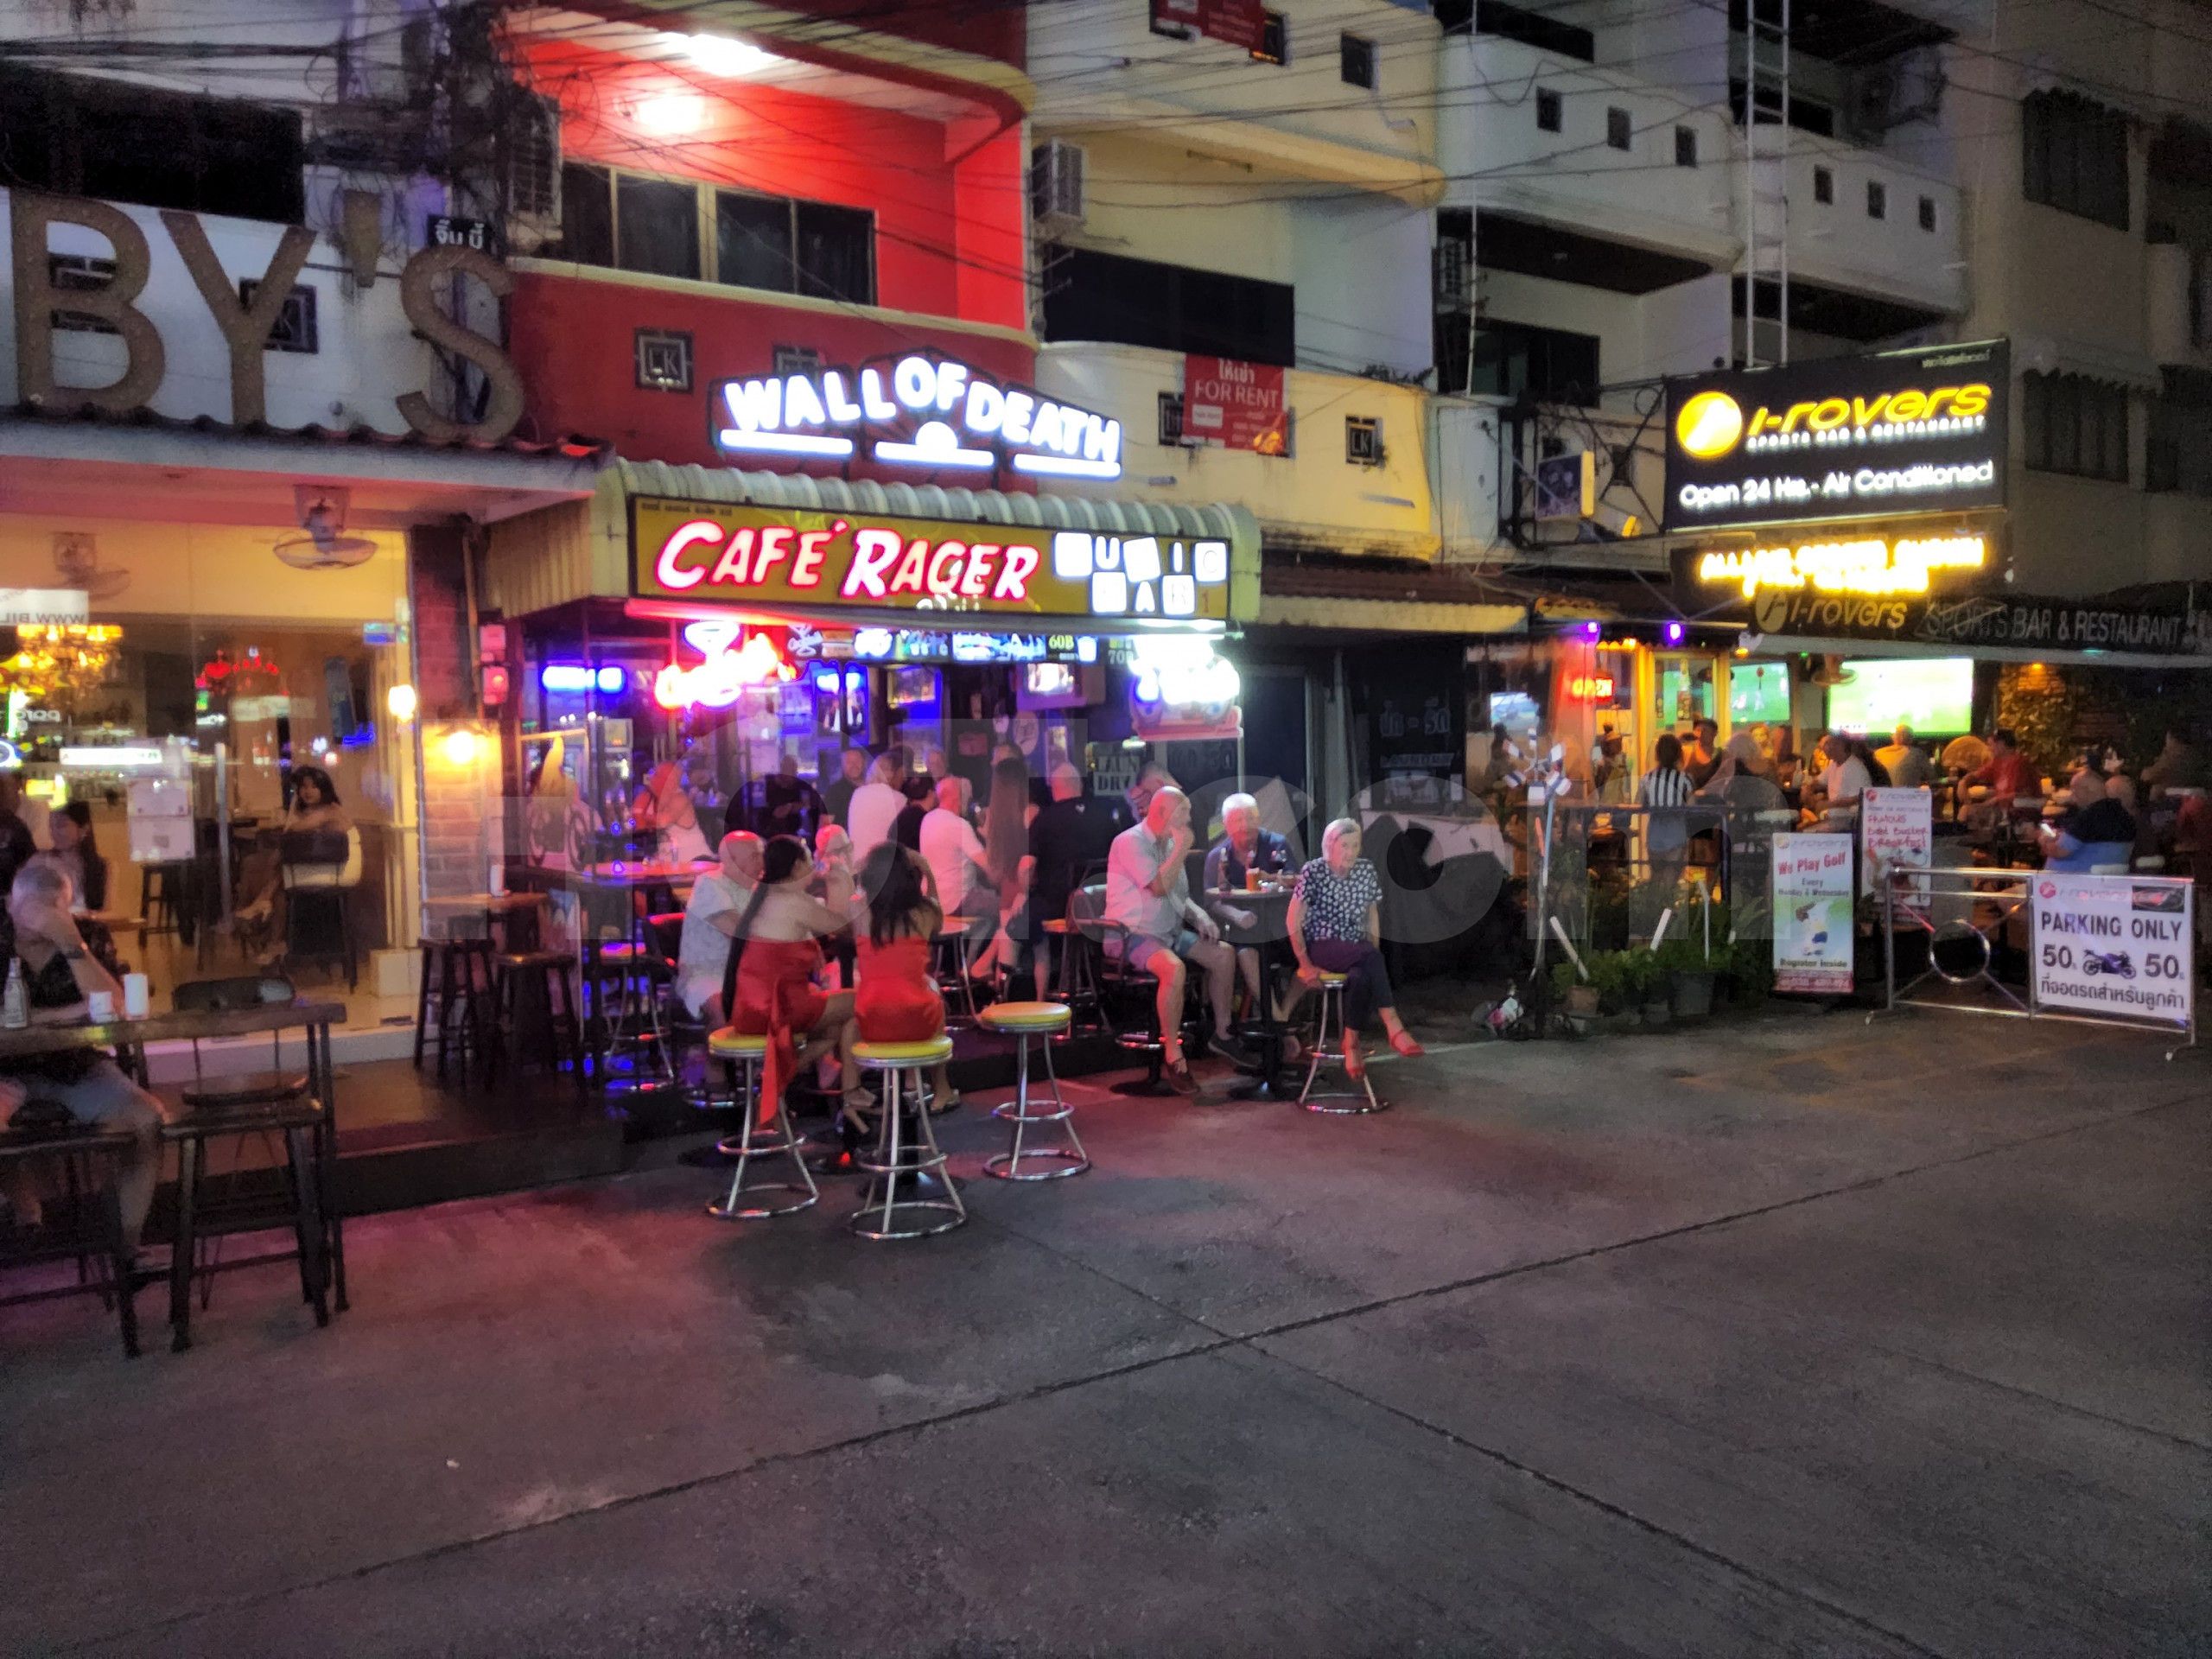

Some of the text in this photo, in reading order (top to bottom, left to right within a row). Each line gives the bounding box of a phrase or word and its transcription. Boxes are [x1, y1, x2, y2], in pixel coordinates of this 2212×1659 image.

[724, 357, 1122, 462] WALL OF DEATH
[1195, 378, 1280, 409] FOR RENT
[1679, 482, 1740, 510] Open
[1743, 477, 1771, 502] 24
[1823, 471, 1851, 494] Air
[1854, 459, 1994, 493] Conditioned
[2012, 607, 2052, 639] BAR
[2057, 611, 2069, 640] &
[2075, 610, 2181, 647] RESTAURANT
[1796, 857, 1820, 873] Play
[1824, 851, 1846, 868] Golf
[1802, 877, 1823, 888] Every
[2041, 911, 2183, 942] PARKING ONLY
[2040, 972, 2185, 1011] ที่จอดรถสำหรับลูกค้า
